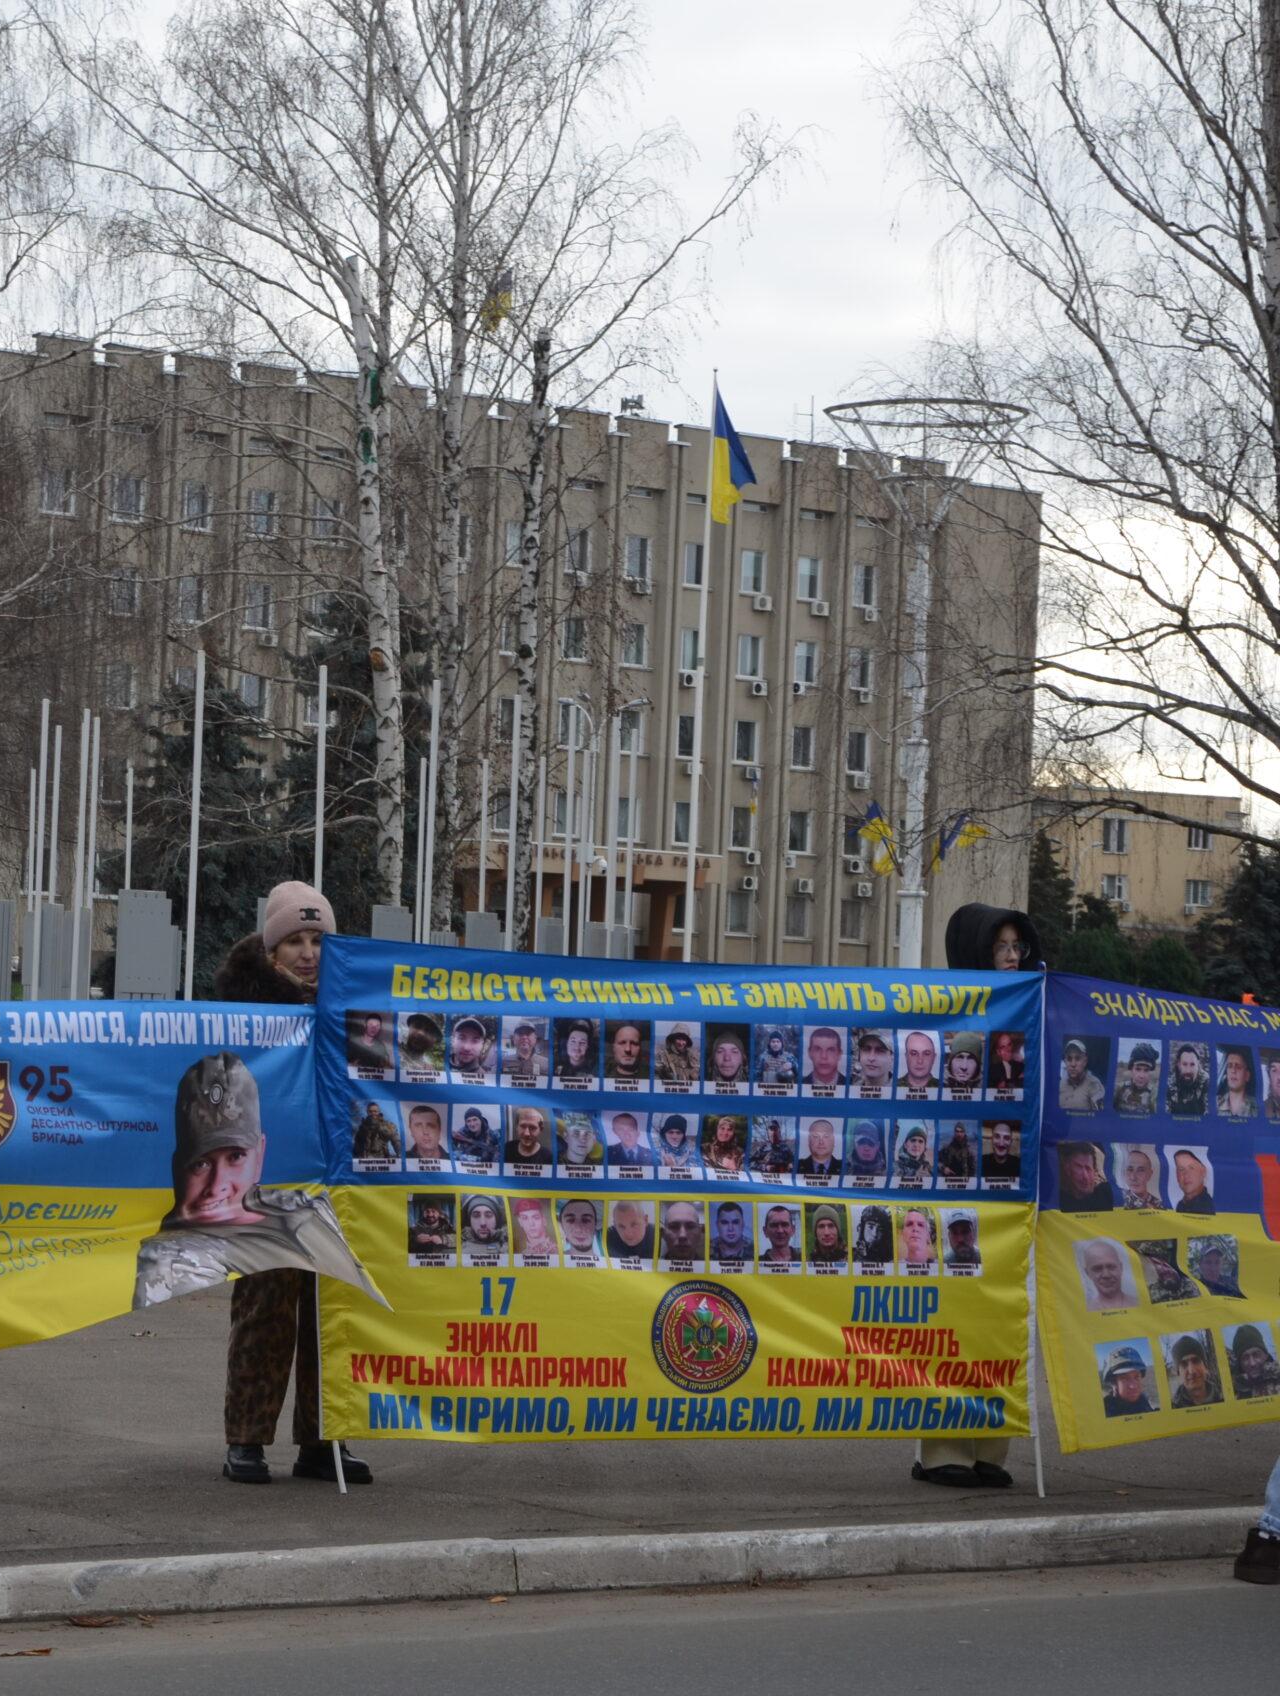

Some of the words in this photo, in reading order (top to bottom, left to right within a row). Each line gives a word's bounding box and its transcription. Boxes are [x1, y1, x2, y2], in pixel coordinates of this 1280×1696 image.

[391, 964, 546, 1002] БЕЗВІСТИ
[550, 977, 674, 1005] ЗНИКЛІ
[695, 983, 738, 1007] НЕ
[744, 982, 886, 1012] ЗНАЧИТЬ
[6, 1011, 134, 1046] ЗДАМОСЯ,
[138, 1011, 198, 1046] ДОКИ
[200, 1013, 225, 1045] ТИ
[227, 1014, 250, 1046] НЕ
[1090, 991, 1213, 1026] ЗНАЙДІТЬ
[1209, 1004, 1267, 1033] НАС,
[18, 1065, 74, 1103] 95
[27, 1105, 75, 1117] ОКРЕМА
[32, 1118, 159, 1133] ДЕСАНТНО-ШТУРМОВА
[32, 1131, 85, 1146] БРИГАДА
[480, 1276, 516, 1316] 17
[851, 1284, 939, 1324] ПКШР
[446, 1322, 538, 1353] ЗНИКЛІ
[841, 1326, 960, 1357] ПОВЕРНІТЬ
[351, 1348, 485, 1388] КУРСЬКИЙ
[491, 1356, 628, 1388] НАПРЯМОК
[767, 1358, 851, 1387] НАШИХ
[934, 1358, 1021, 1389] ДОДОМУ
[368, 1392, 423, 1431] МИ
[430, 1396, 575, 1436] ВІРИМО,
[583, 1396, 639, 1432] МИ
[646, 1396, 805, 1436] ЧЕКАЄМО,
[812, 1396, 863, 1432] МИ
[867, 1396, 1006, 1432] ЛЮБИМО
